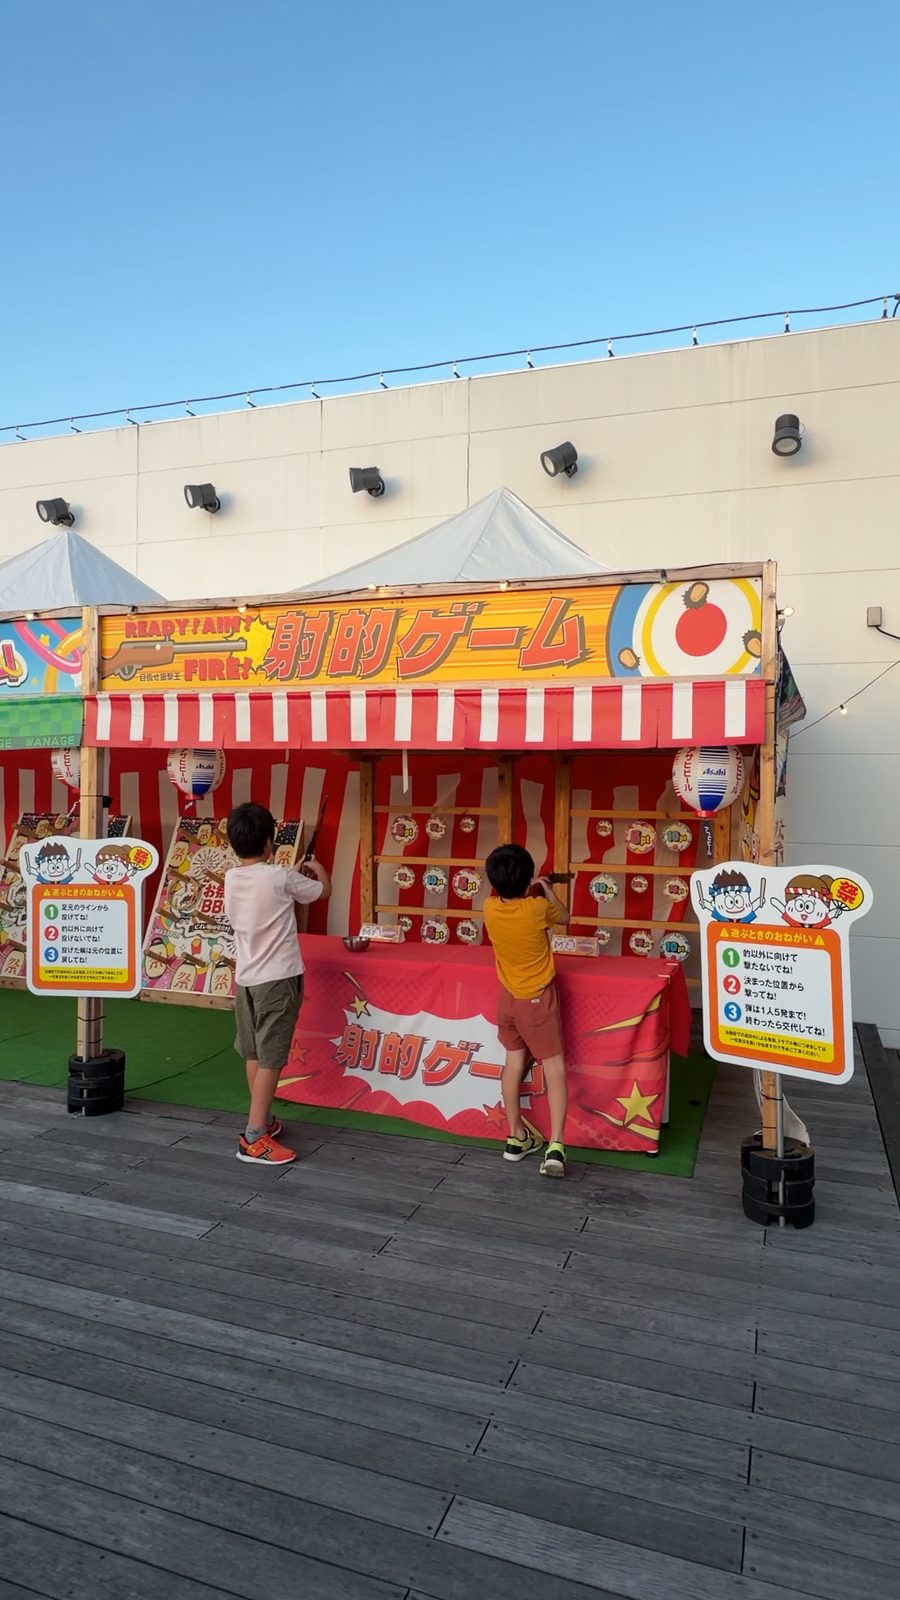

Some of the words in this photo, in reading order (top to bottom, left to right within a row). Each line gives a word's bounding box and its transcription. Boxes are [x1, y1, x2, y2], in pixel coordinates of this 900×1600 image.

[263, 597, 586, 679] 射的ゲーム
[184, 657, 252, 681] FIRE!
[26, 735, 75, 747] WANAGE
[702, 767, 726, 777] Asahi
[52, 888, 116, 897] 遊ぶときのおねがい
[837, 880, 859, 905] 祭
[47, 906, 54, 918] 1
[61, 903, 109, 912] 足元のラインから
[201, 899, 226, 914] BB
[47, 927, 56, 939] 2
[61, 925, 104, 933] 的以外に向けて
[730, 927, 813, 943] 遊ぶときのおねがい
[48, 948, 56, 961] 3
[61, 946, 123, 955] 投げた輪は元の位置に
[727, 950, 735, 964] 1
[743, 949, 798, 963] 的以外に向けて
[743, 961, 793, 975] 撃たないでね!
[174, 971, 192, 990] 祭
[214, 973, 229, 990] 祭
[727, 977, 737, 992] 2
[744, 976, 805, 992] 決まった位置から
[744, 988, 777, 1000] 撃ってね!
[728, 1004, 738, 1019] 3
[745, 1003, 807, 1020] 弾は1人5発まで!
[745, 1016, 825, 1036] 終わったら交代してね!
